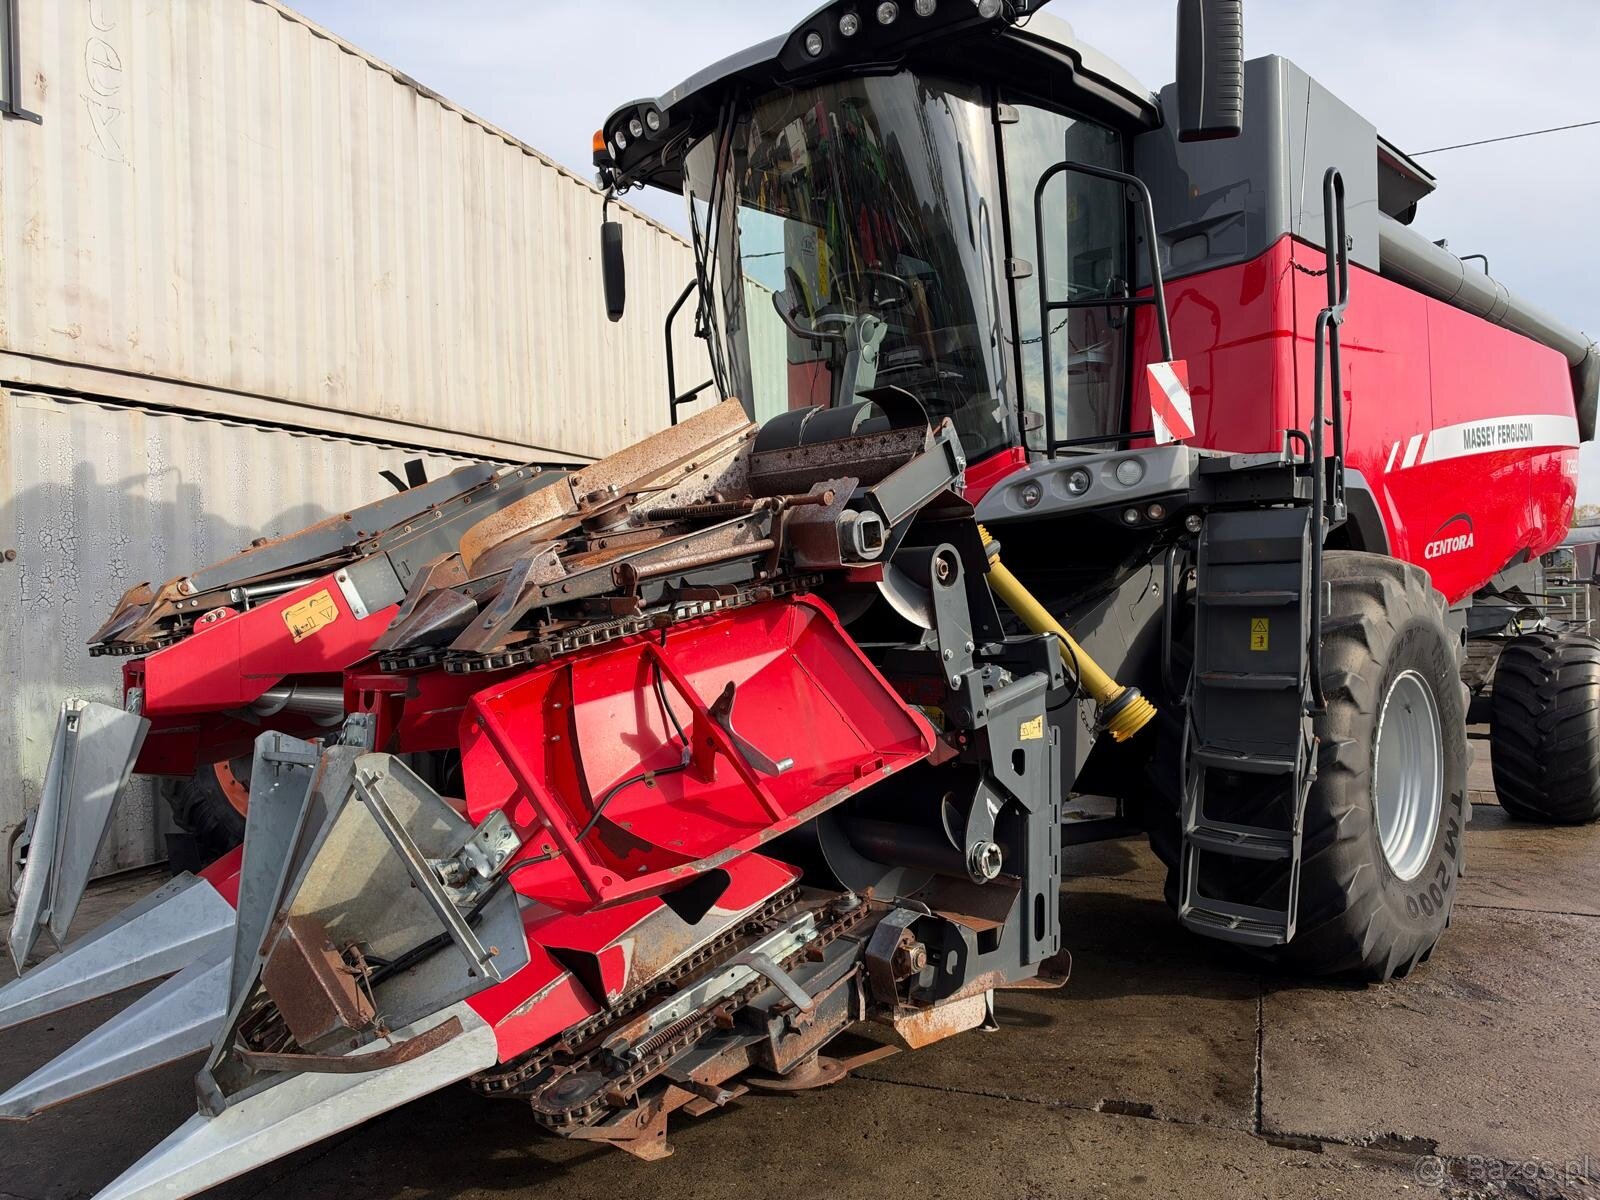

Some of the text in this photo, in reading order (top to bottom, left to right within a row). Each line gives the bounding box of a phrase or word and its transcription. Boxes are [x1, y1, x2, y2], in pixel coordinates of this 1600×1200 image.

[1463, 423, 1533, 450] MASSEY FERGUSON
[1424, 533, 1474, 560] CENTORA
